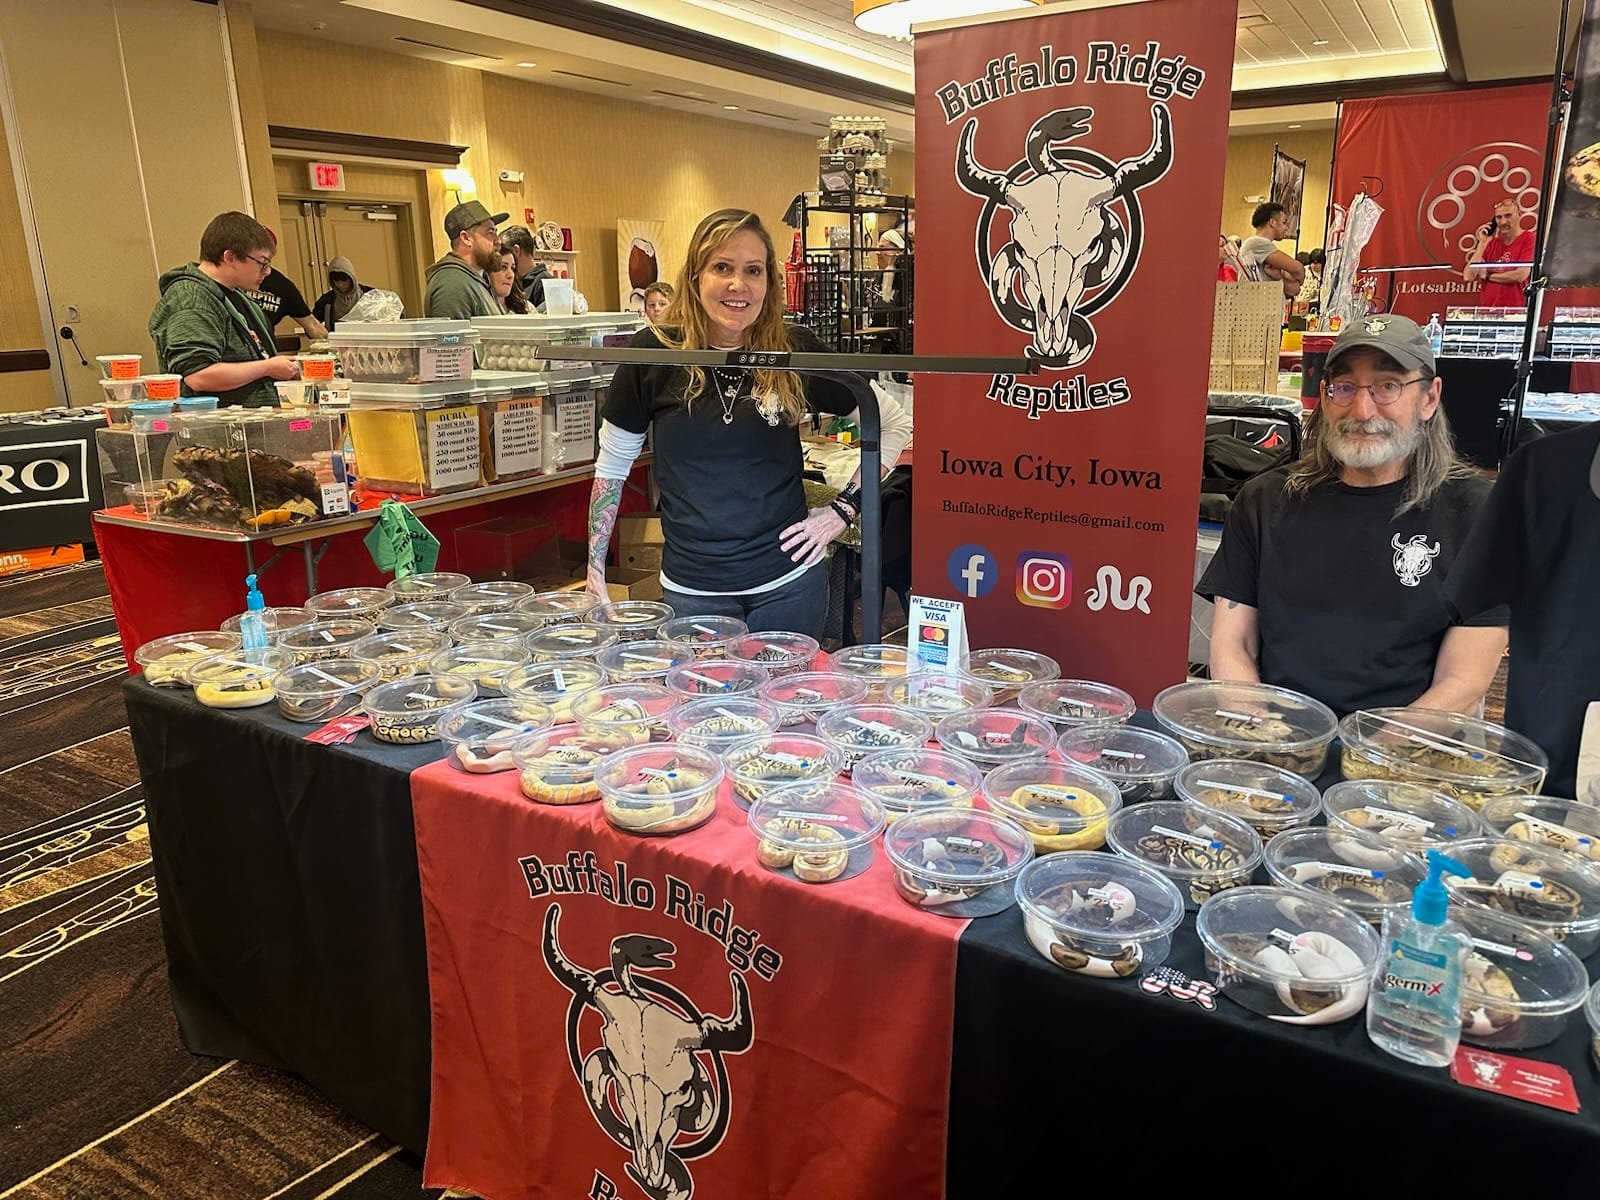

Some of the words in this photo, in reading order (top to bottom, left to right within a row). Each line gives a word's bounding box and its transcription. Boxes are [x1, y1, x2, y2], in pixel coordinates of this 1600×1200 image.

[936, 45, 1077, 124] Buffalo
[1084, 41, 1205, 100] Ridge
[316, 165, 339, 187] EXIT
[509, 402, 533, 411] DUBIA
[986, 374, 1131, 420] Reptiles
[440, 411, 467, 422] DUBIA
[940, 450, 1003, 478] Iowa
[1014, 454, 1076, 488] City,
[1088, 458, 1162, 490] Iowa
[942, 500, 1165, 532] BuffaloRidgeReptiles@gmail.com
[912, 597, 925, 605] WE
[928, 599, 960, 610] ACCEPT
[924, 611, 947, 622] VISA
[518, 850, 655, 910] Buffalo
[663, 874, 783, 982] Ridge
